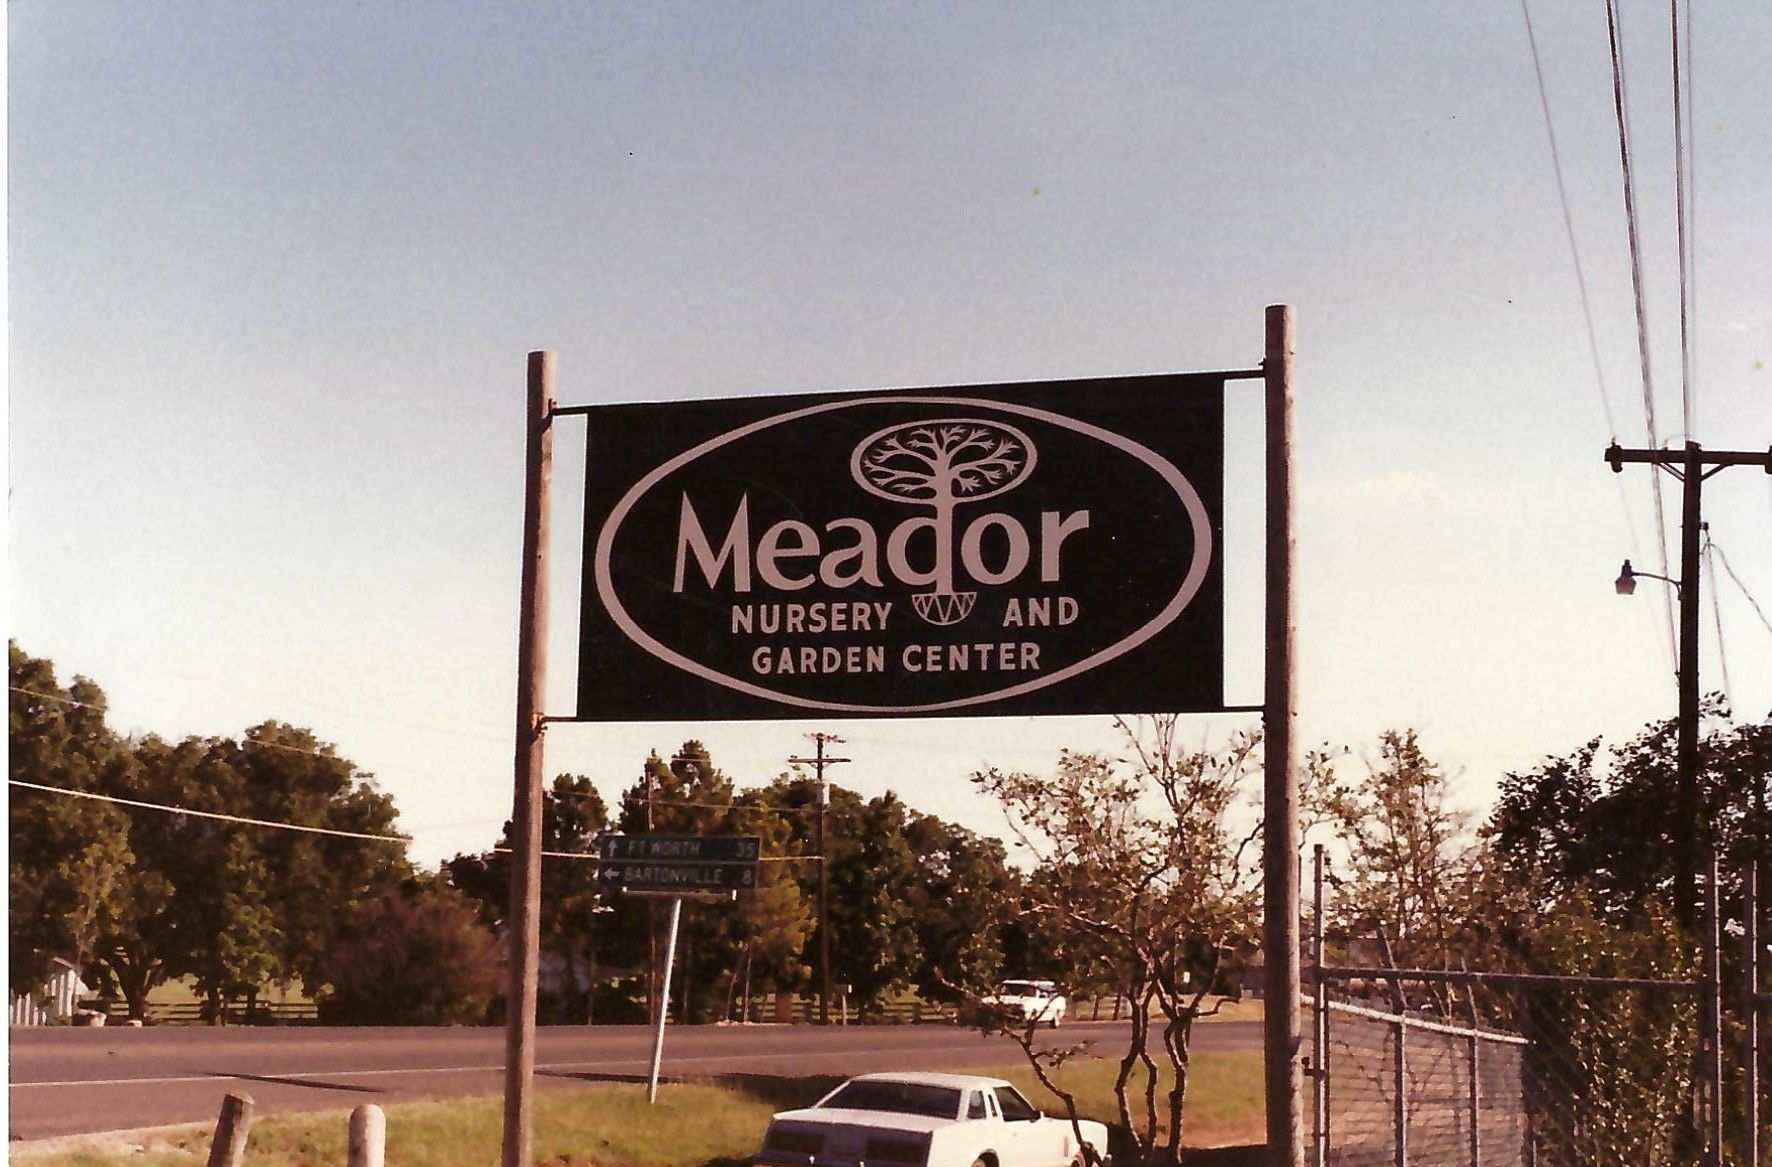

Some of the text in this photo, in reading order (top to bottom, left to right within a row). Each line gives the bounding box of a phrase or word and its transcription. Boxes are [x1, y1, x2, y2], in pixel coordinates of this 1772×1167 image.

[673, 490, 1090, 597] Meador
[731, 597, 1080, 633] NURSERY AND
[752, 642, 1040, 674] GARDEN CENTER
[650, 841, 702, 857] WORTH
[624, 865, 723, 885] BARTONVILLE
